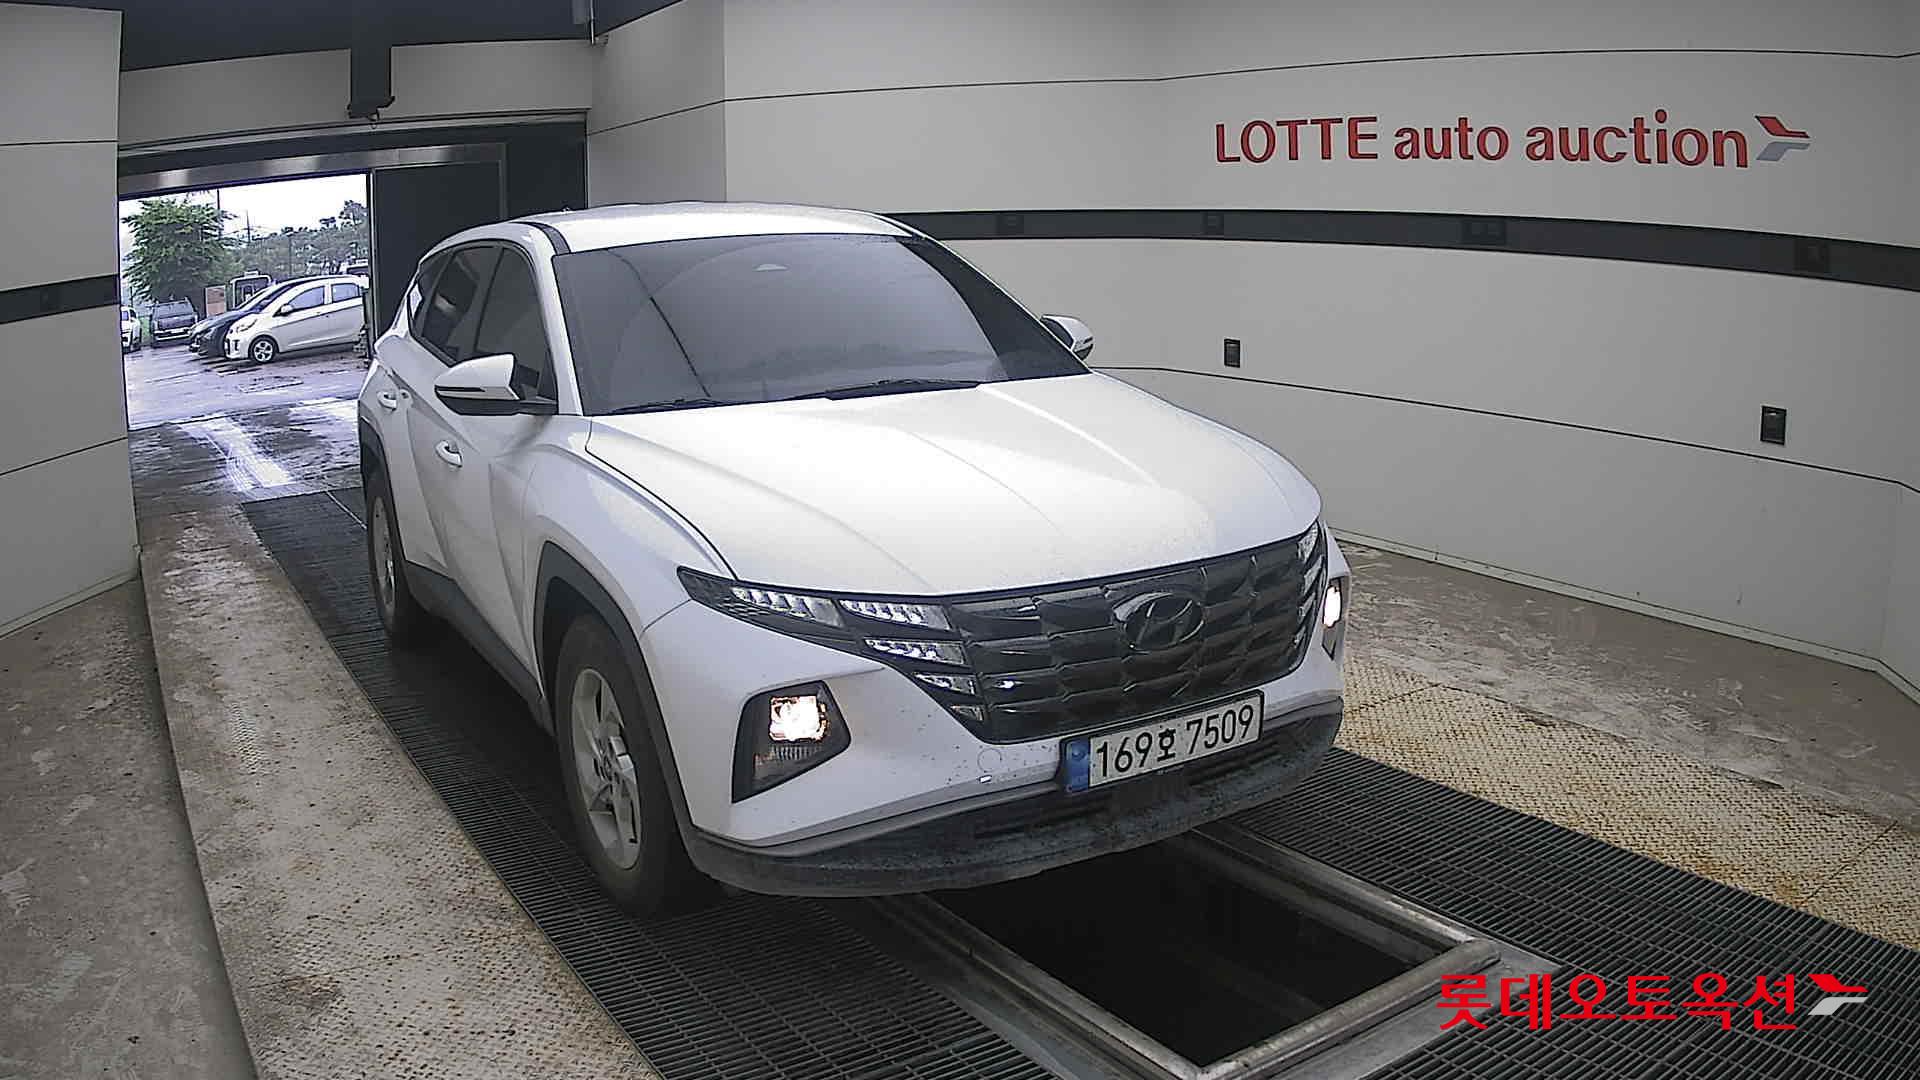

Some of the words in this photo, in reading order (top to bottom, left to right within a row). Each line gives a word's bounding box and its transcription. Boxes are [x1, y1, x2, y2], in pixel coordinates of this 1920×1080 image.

[1215, 116, 1378, 163] LOTTE
[1394, 117, 1509, 161] auto
[1525, 109, 1749, 168] auction
[1096, 727, 1176, 777] 169호
[1186, 705, 1254, 754] 7509
